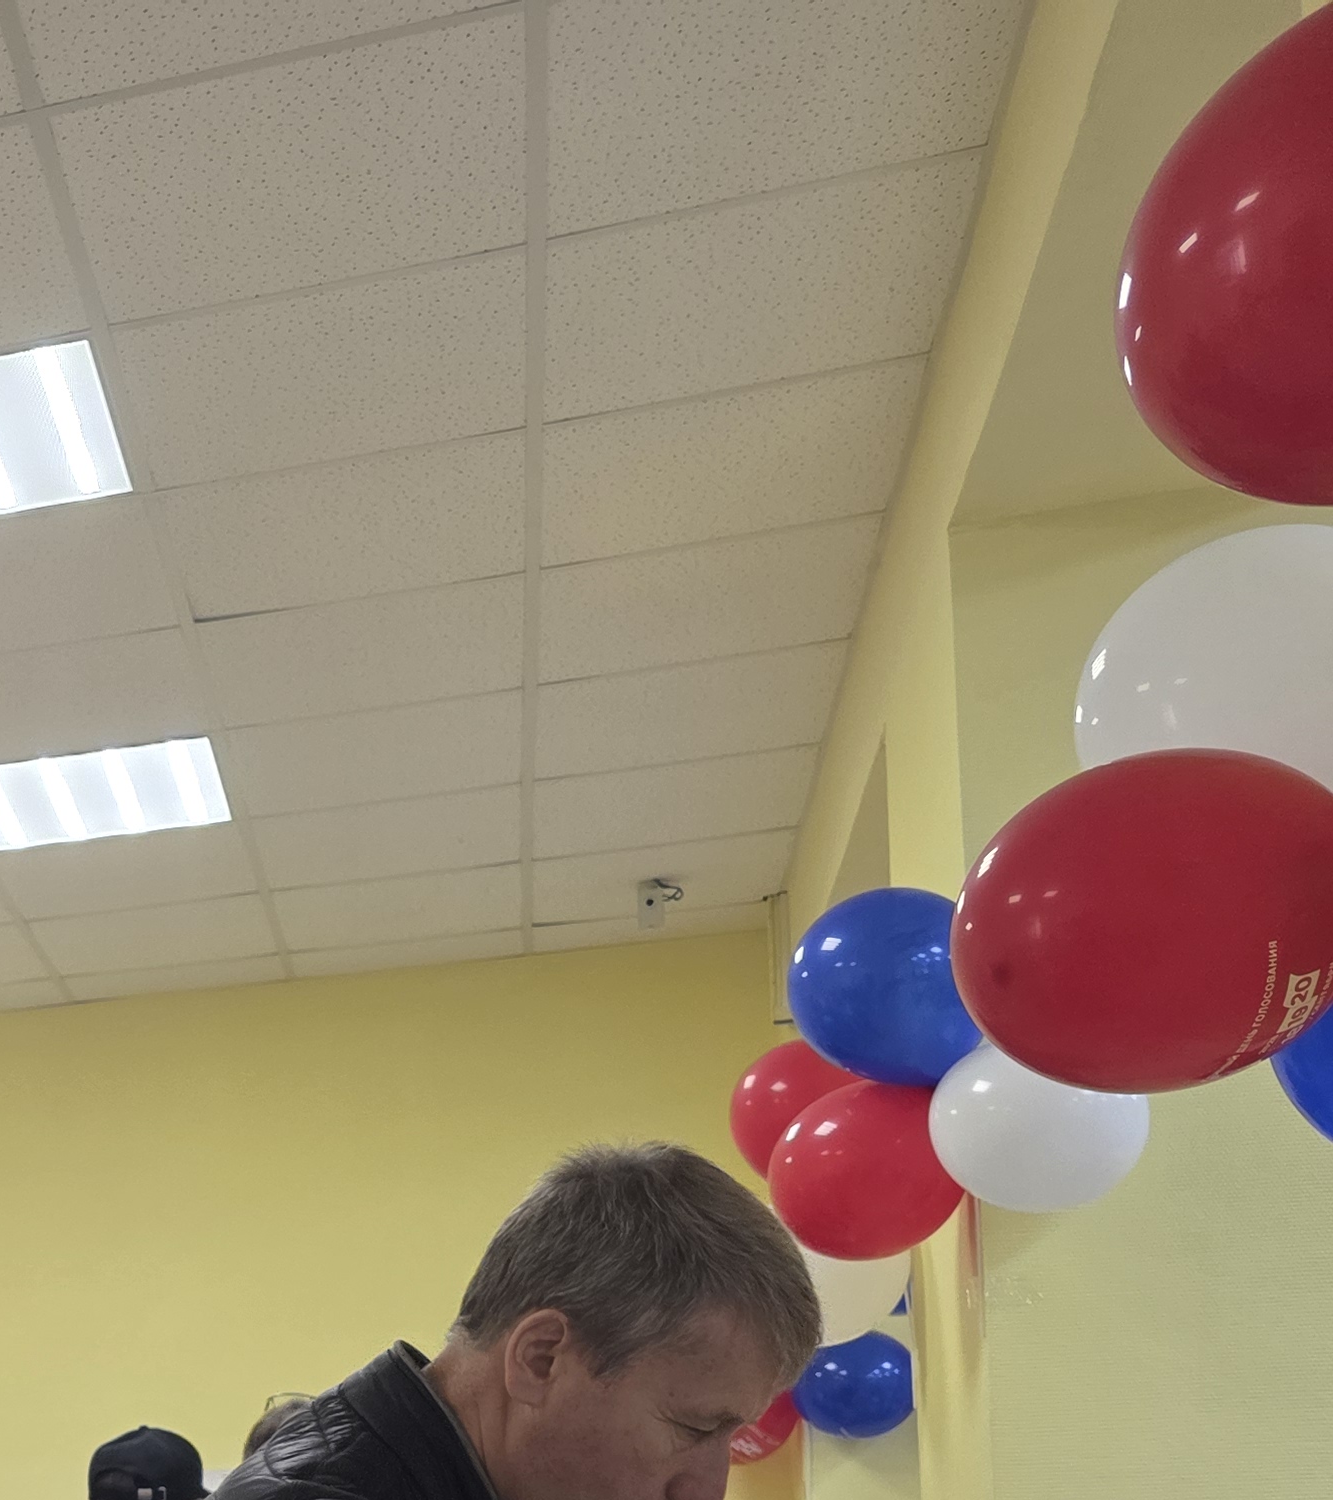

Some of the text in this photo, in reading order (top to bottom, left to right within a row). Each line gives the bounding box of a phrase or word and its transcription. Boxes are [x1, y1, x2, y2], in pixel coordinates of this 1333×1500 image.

[1252, 940, 1278, 1028] ГОЛОСОВАНИЯ
[1290, 976, 1312, 1006] 20
[1288, 1005, 1309, 1027] 19
